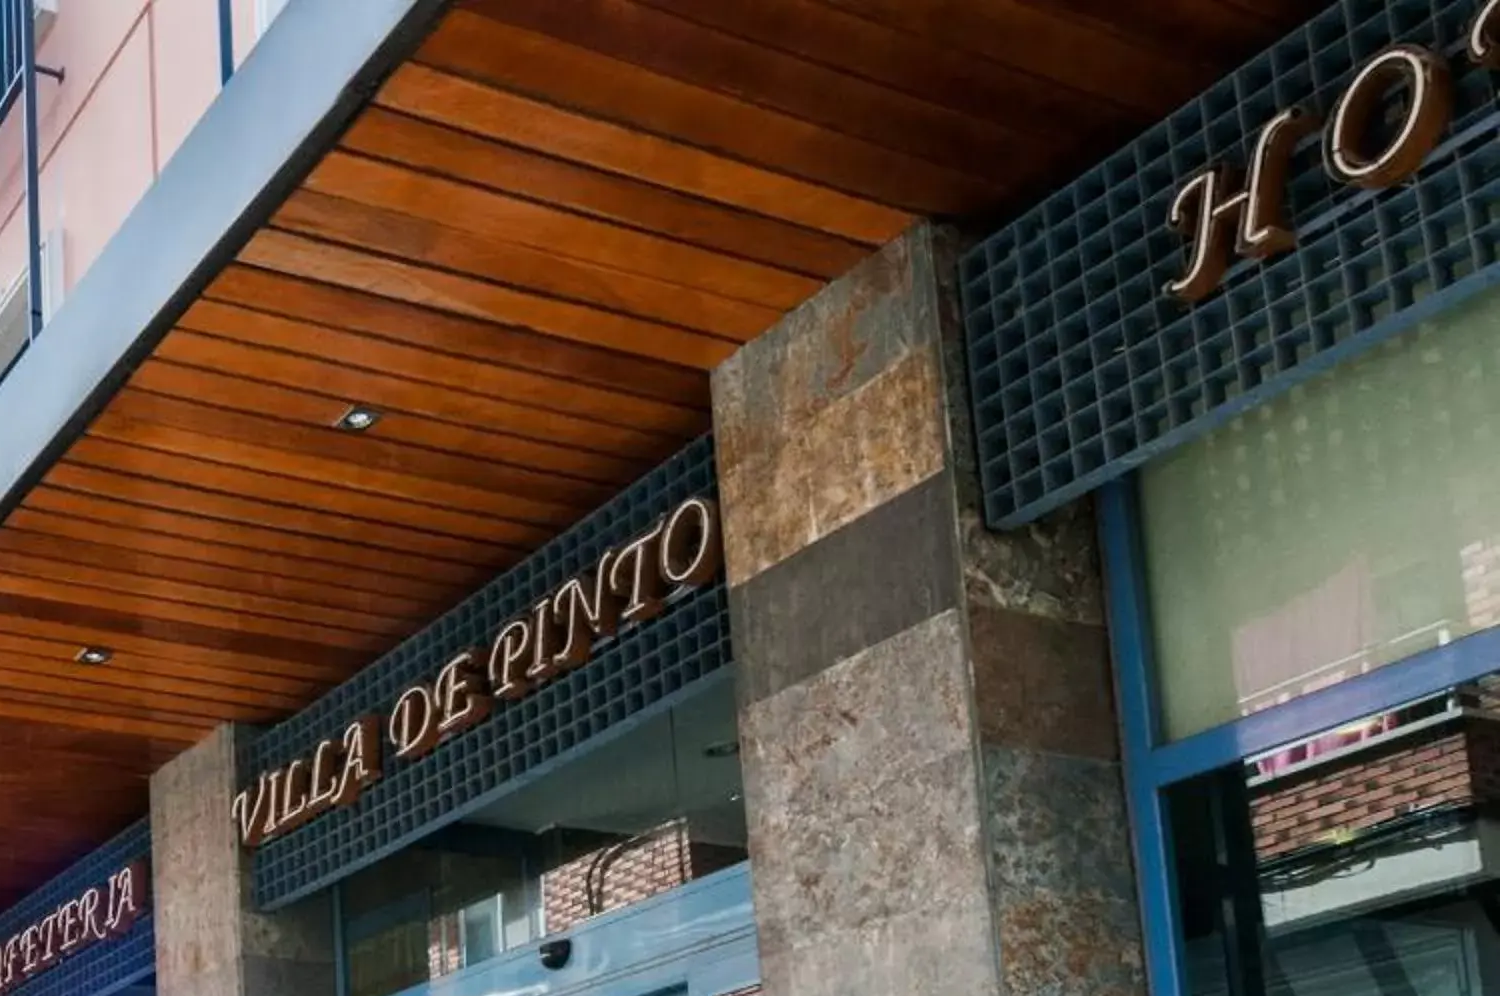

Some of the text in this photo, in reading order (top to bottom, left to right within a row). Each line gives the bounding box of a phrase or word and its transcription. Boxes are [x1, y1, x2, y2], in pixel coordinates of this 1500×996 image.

[1163, 0, 1500, 302] HO
[231, 499, 711, 842] VILLA DE PINTO
